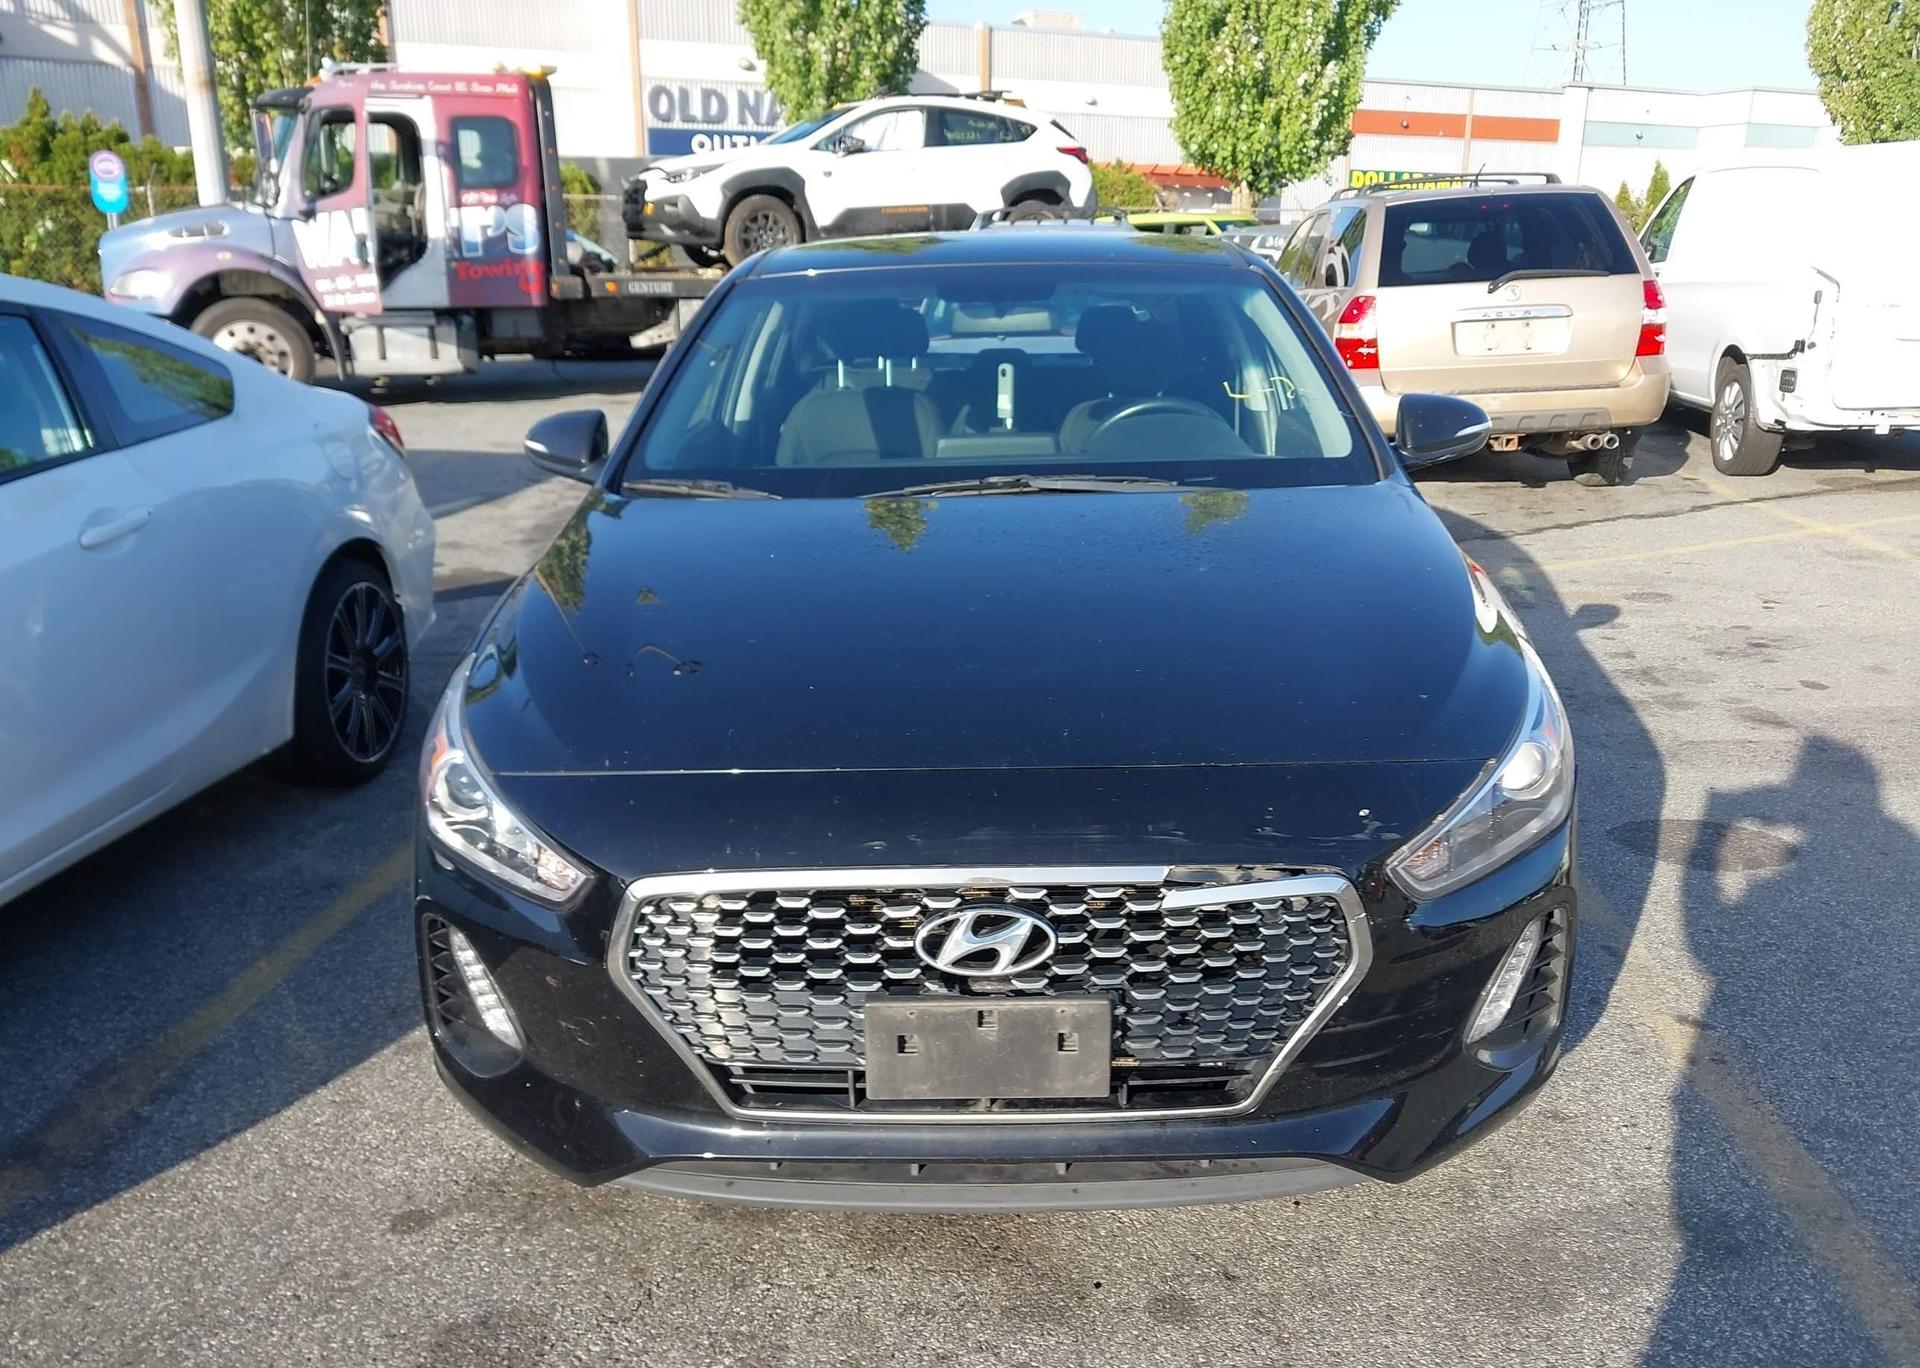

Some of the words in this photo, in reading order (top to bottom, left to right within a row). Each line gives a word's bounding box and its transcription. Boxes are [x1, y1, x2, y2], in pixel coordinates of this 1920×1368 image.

[648, 85, 729, 124] OLD
[456, 258, 544, 294] Towing
[628, 280, 673, 294] CENTURY
